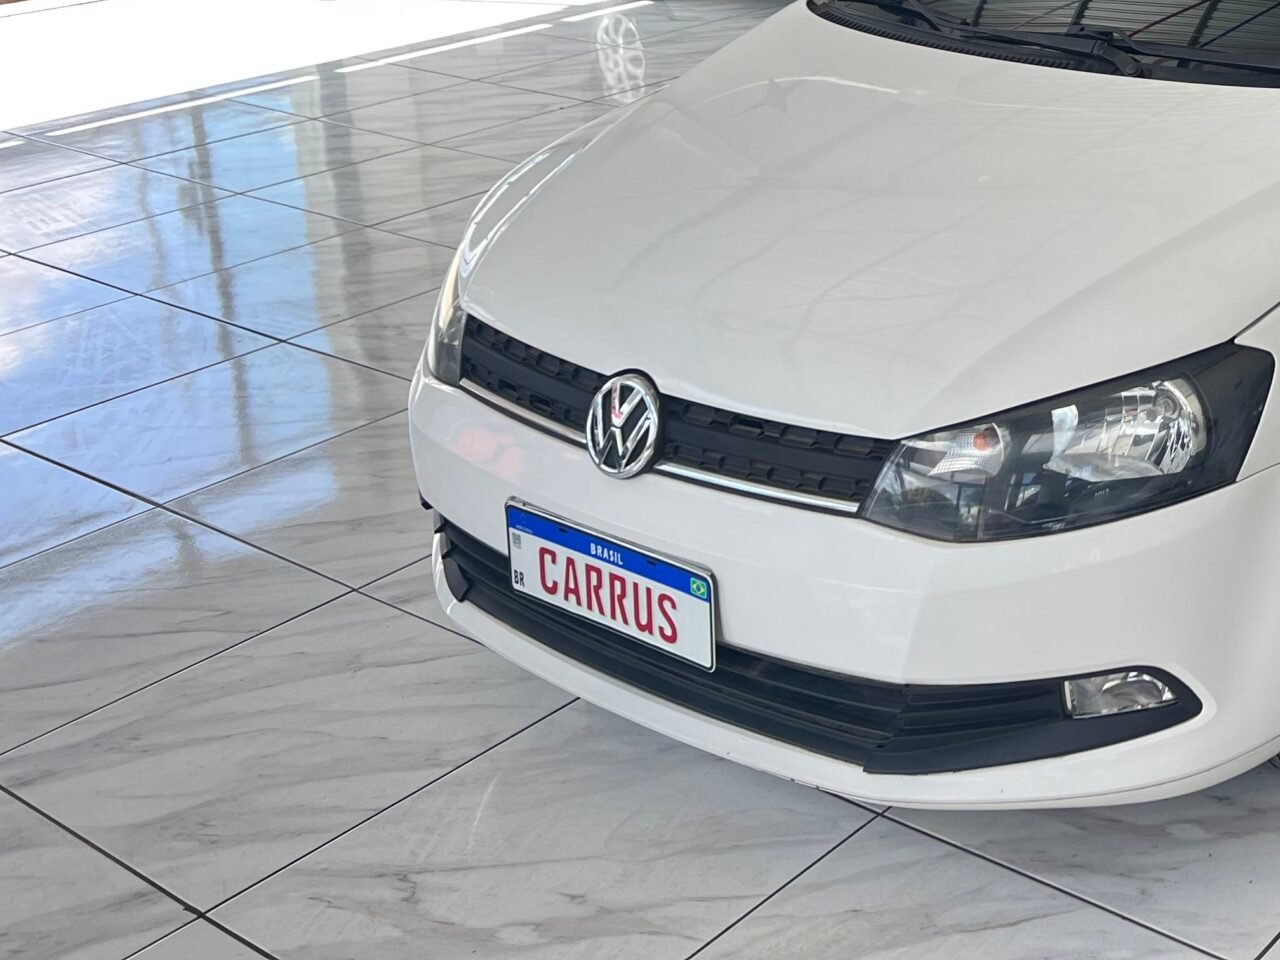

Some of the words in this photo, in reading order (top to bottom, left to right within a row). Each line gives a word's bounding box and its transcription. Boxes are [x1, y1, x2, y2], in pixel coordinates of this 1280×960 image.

[590, 542, 624, 566] BRASIL
[513, 569, 526, 587] BR
[538, 546, 678, 645] CARRUS
